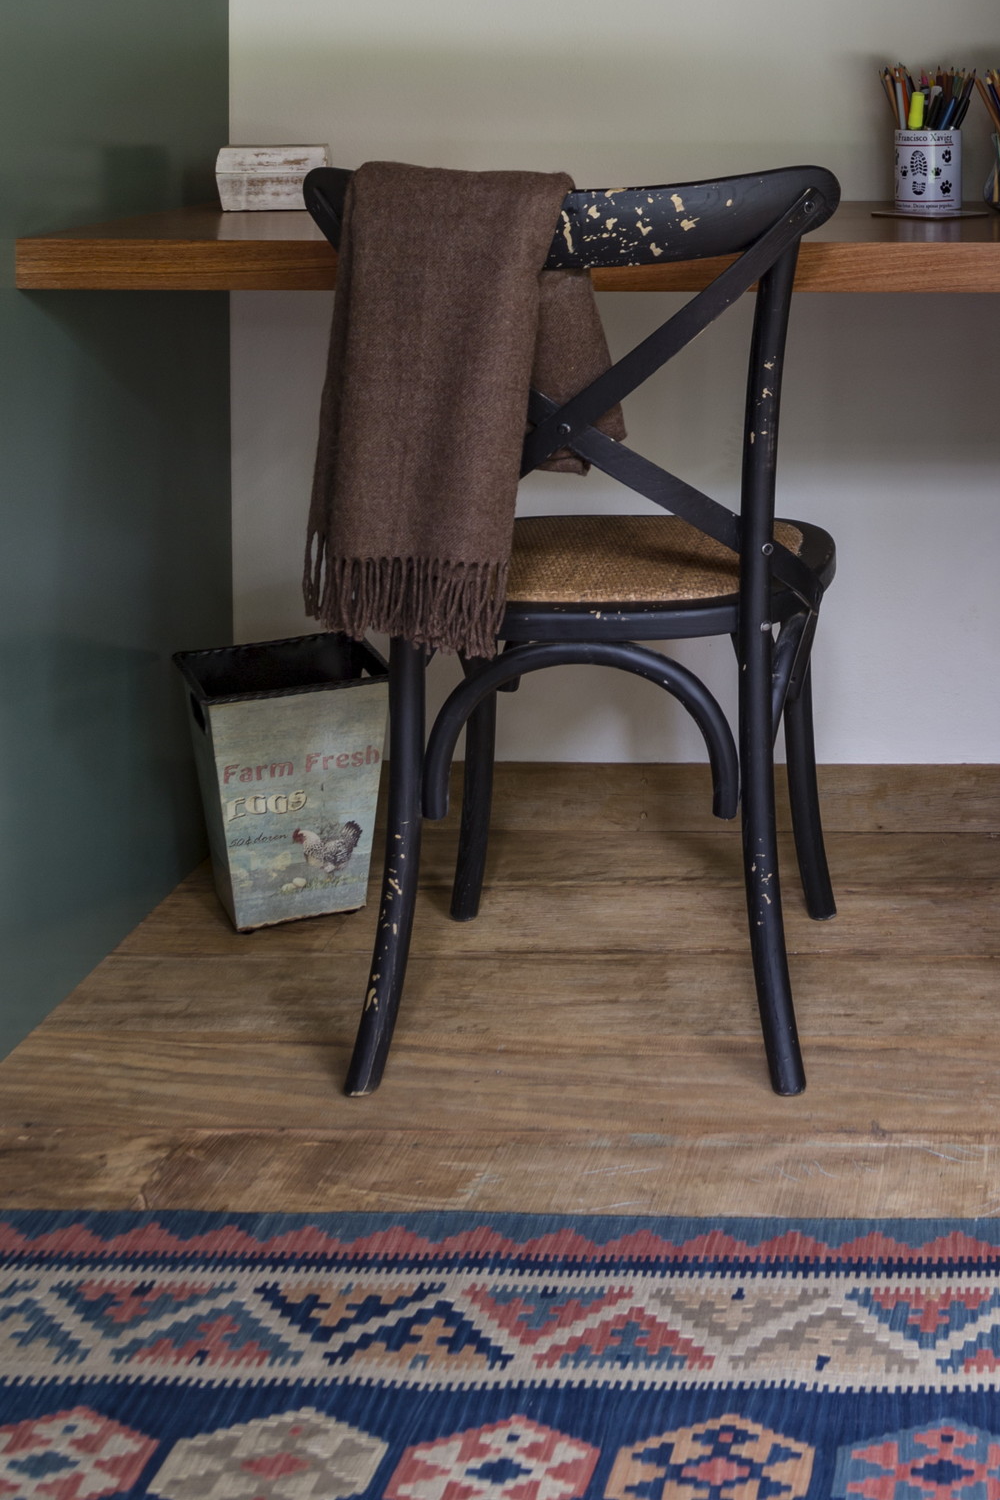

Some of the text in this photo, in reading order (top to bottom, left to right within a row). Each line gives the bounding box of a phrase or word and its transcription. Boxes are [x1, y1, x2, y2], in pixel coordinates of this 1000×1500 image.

[898, 133, 953, 142] Francisco Xavier
[223, 744, 380, 785] Farm Fresh
[226, 789, 308, 822] EGGS
